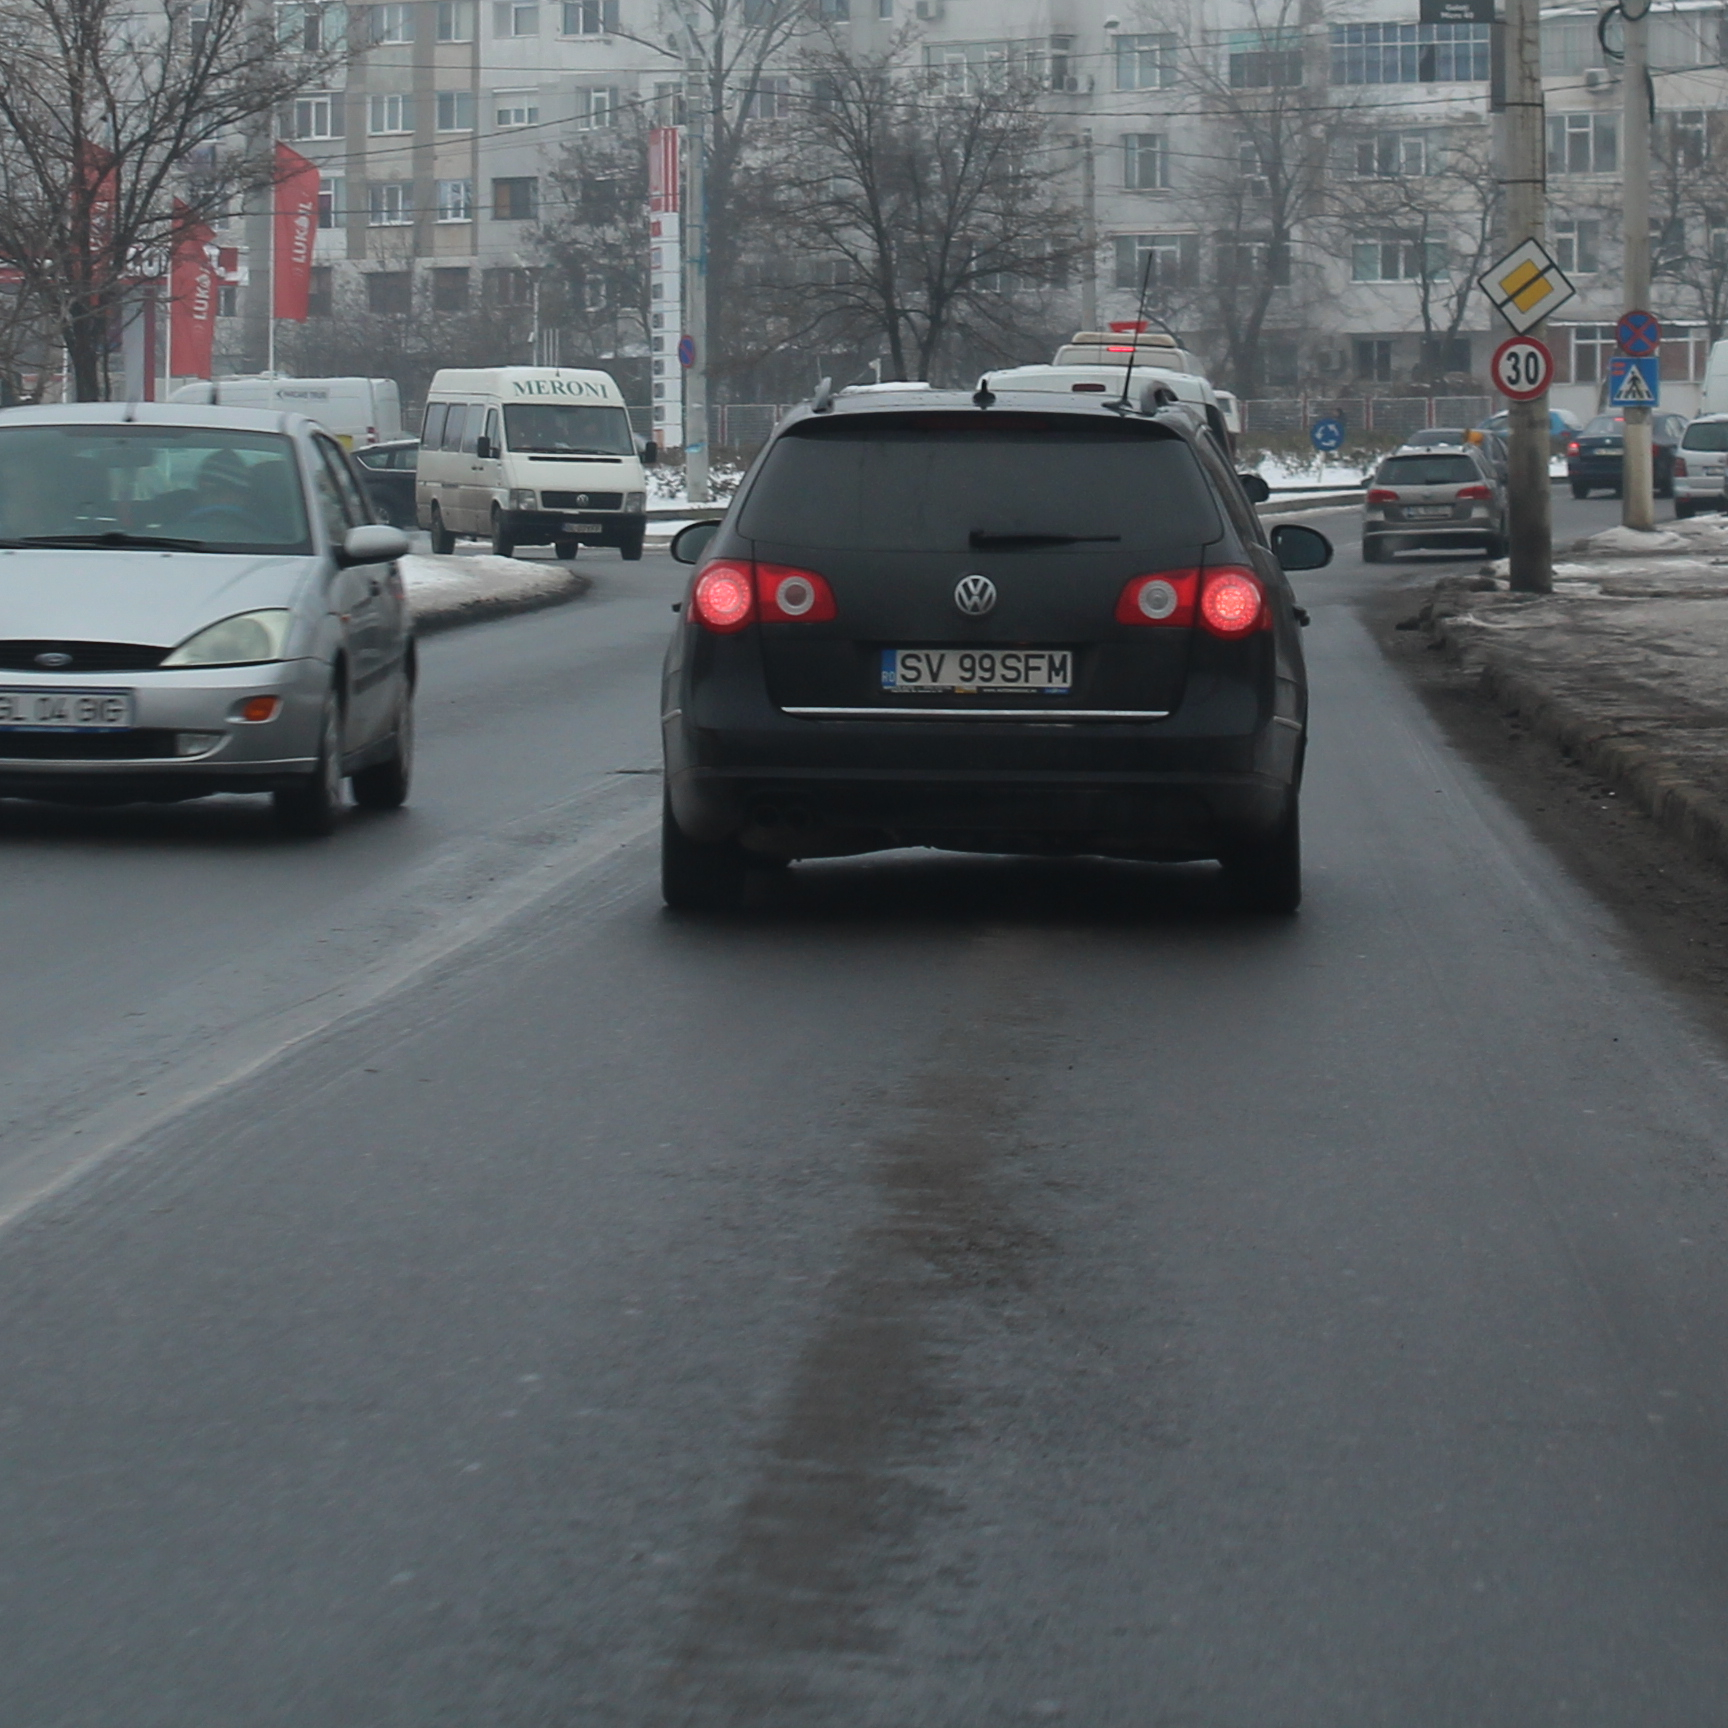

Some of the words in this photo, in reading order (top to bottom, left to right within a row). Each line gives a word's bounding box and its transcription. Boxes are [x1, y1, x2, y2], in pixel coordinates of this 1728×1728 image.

[291, 201, 313, 264] LUKOIL
[1506, 351, 1539, 385] 30
[512, 379, 609, 399] MERONI
[900, 653, 945, 683] SV
